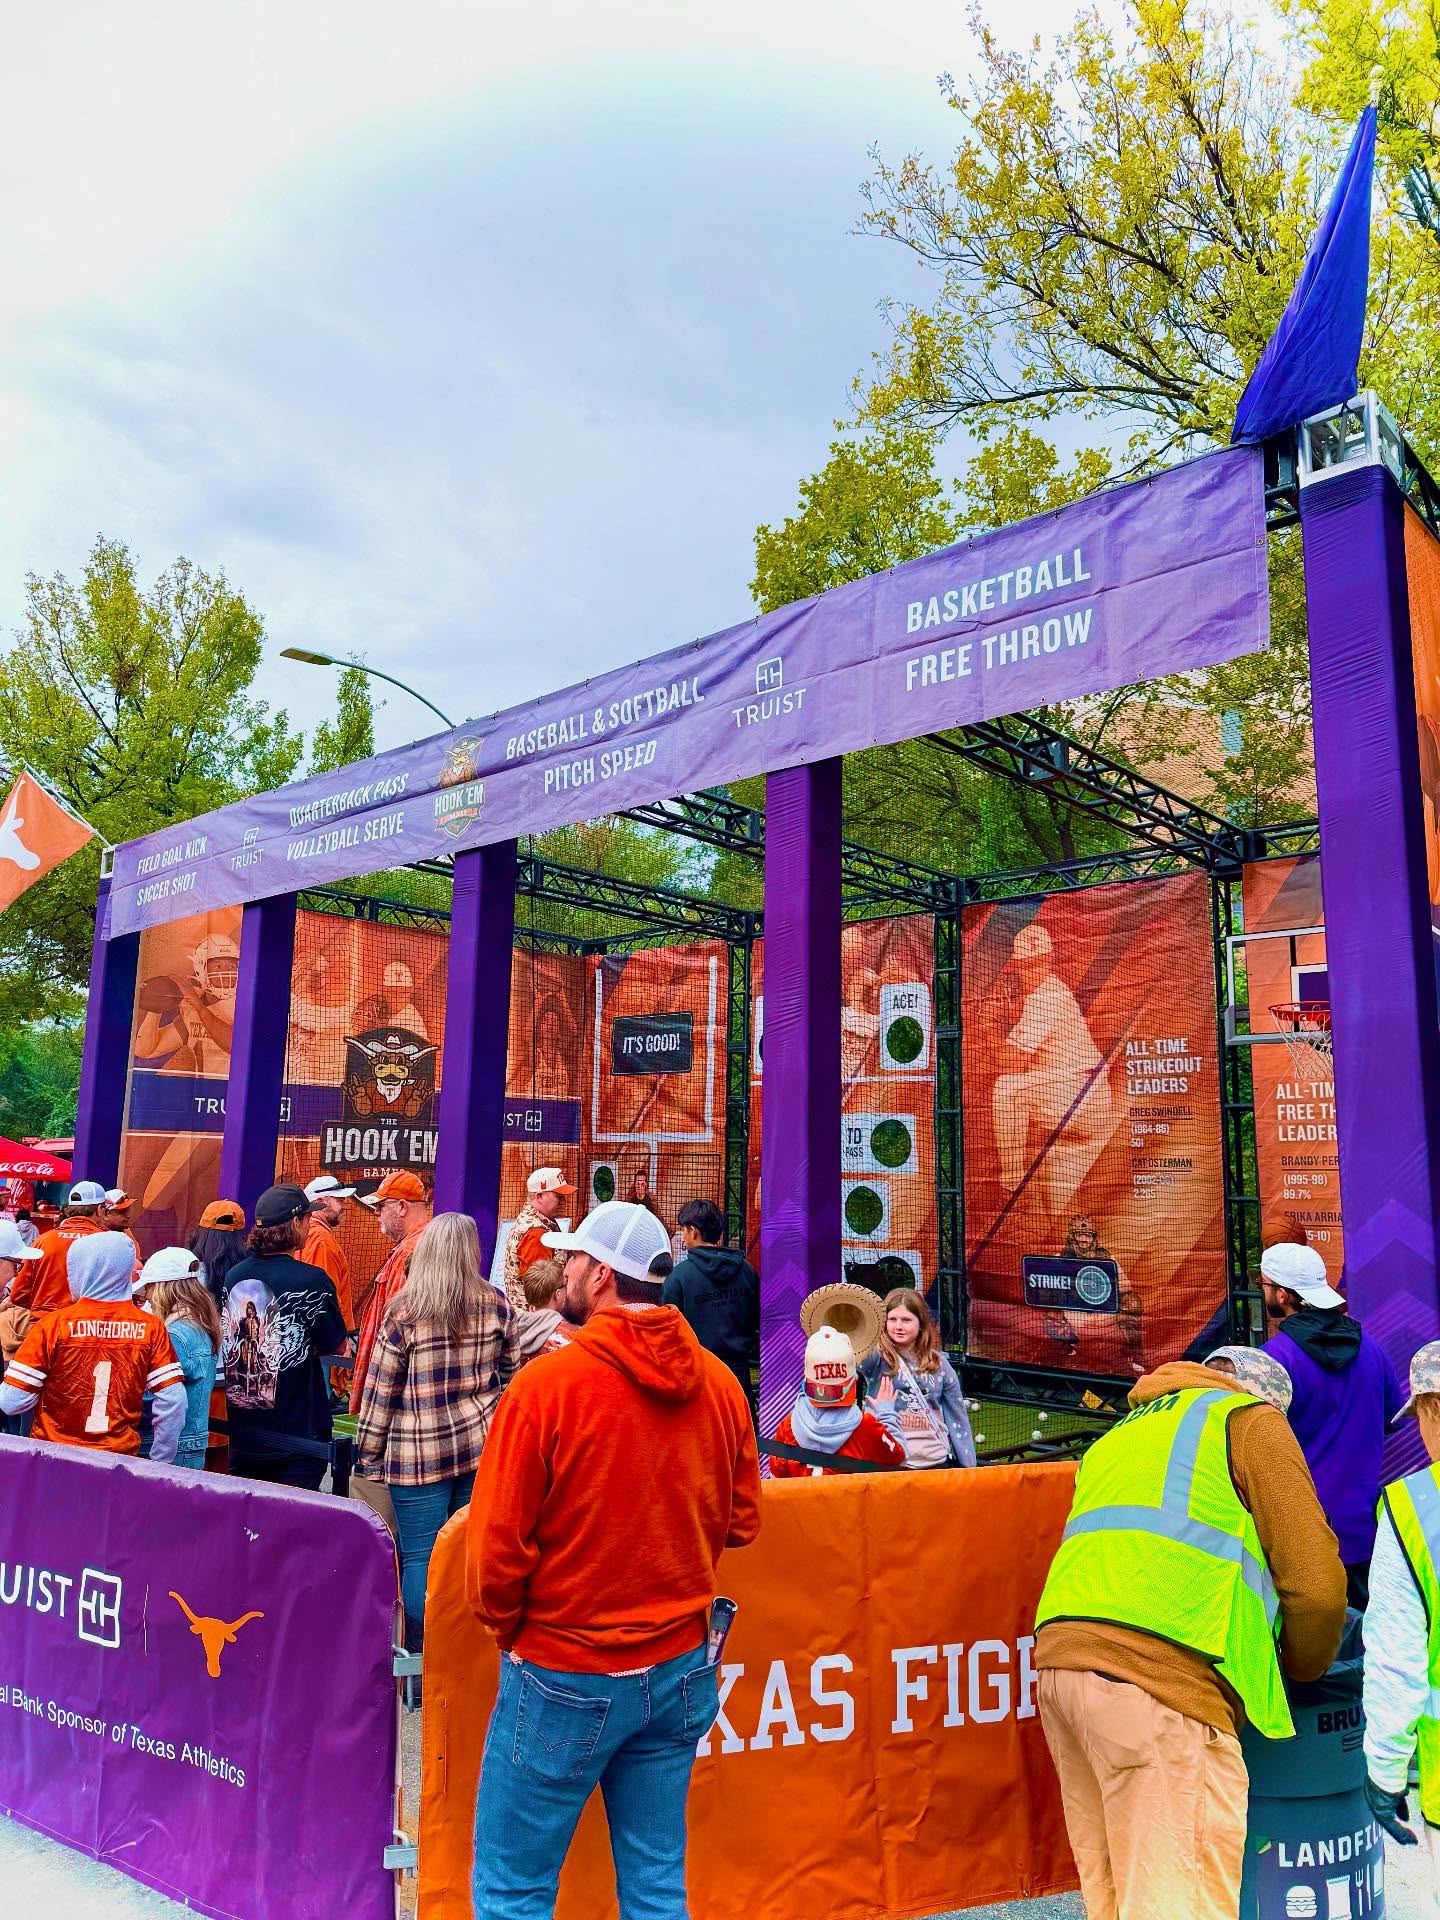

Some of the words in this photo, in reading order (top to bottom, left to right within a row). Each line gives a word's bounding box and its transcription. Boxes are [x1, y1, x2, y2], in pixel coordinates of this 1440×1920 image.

[906, 548, 1091, 634] BASKETBALL
[906, 643, 973, 692] FREE
[981, 608, 1093, 670] THROW
[505, 713, 589, 761] BASEBALL
[591, 707, 605, 735] &
[608, 676, 705, 729] SOFTBALL
[732, 688, 807, 728] TRUIST
[543, 757, 595, 794] PITCH
[600, 740, 657, 780] SPEED
[289, 784, 374, 828] QUARTERBACK
[373, 773, 410, 800] PASS
[434, 790, 464, 818] HOOK
[466, 783, 484, 807] 'EM
[286, 825, 360, 861] VOLLEYBALL
[364, 812, 405, 842] SERVE
[136, 852, 160, 876] FIELD
[161, 845, 183, 868] GOAL
[185, 836, 208, 860] KICK
[231, 848, 264, 871] TRUIST
[136, 879, 170, 906] SOCCER
[171, 872, 197, 895] SHOT
[892, 993, 919, 1010] ACE!
[622, 1035, 644, 1054] IT'S
[645, 1032, 680, 1053] GOOD!
[1126, 1038, 1189, 1056] ALL-TIME
[1126, 1056, 1203, 1075] STRIKEOUT
[1127, 1076, 1188, 1095] LEADERS
[1275, 1081, 1335, 1100] ALL-TIM
[1129, 1106, 1151, 1117] GREG
[1151, 1105, 1193, 1117] SWINDELL
[1277, 1103, 1315, 1120] FREE
[1319, 1102, 1337, 1120] TH
[847, 1127, 862, 1145] TD
[1278, 1124, 1337, 1142] LEADER
[324, 1127, 400, 1164] HOOK
[403, 1128, 439, 1164] 'EM
[845, 1146, 864, 1158] PASS
[1132, 1158, 1147, 1168] CAT
[1148, 1158, 1193, 1168] OSTERMAN
[1281, 1155, 1320, 1166] BRANDY
[1322, 1155, 1339, 1166] PER
[363, 1167, 405, 1178] GAM
[1283, 1174, 1328, 1187] (1995-98)
[1283, 1189, 1311, 1199] 89.7%
[1314, 1211, 1343, 1223] ARRIA
[1029, 1273, 1071, 1290] STRIKE!
[67, 1319, 147, 1340] LONGHORNS
[813, 1363, 848, 1380] TEXAS
[84, 1360, 112, 1433] 1
[0, 1562, 73, 1617] UIST
[695, 1653, 855, 1758] XAS
[1317, 1705, 1364, 1735] BRU
[0, 1684, 9, 1704] al
[12, 1687, 44, 1718] Bank
[47, 1700, 107, 1737] Sponsor
[111, 1723, 127, 1744] of
[130, 1725, 176, 1760] Texas
[180, 1742, 246, 1788] Athletics
